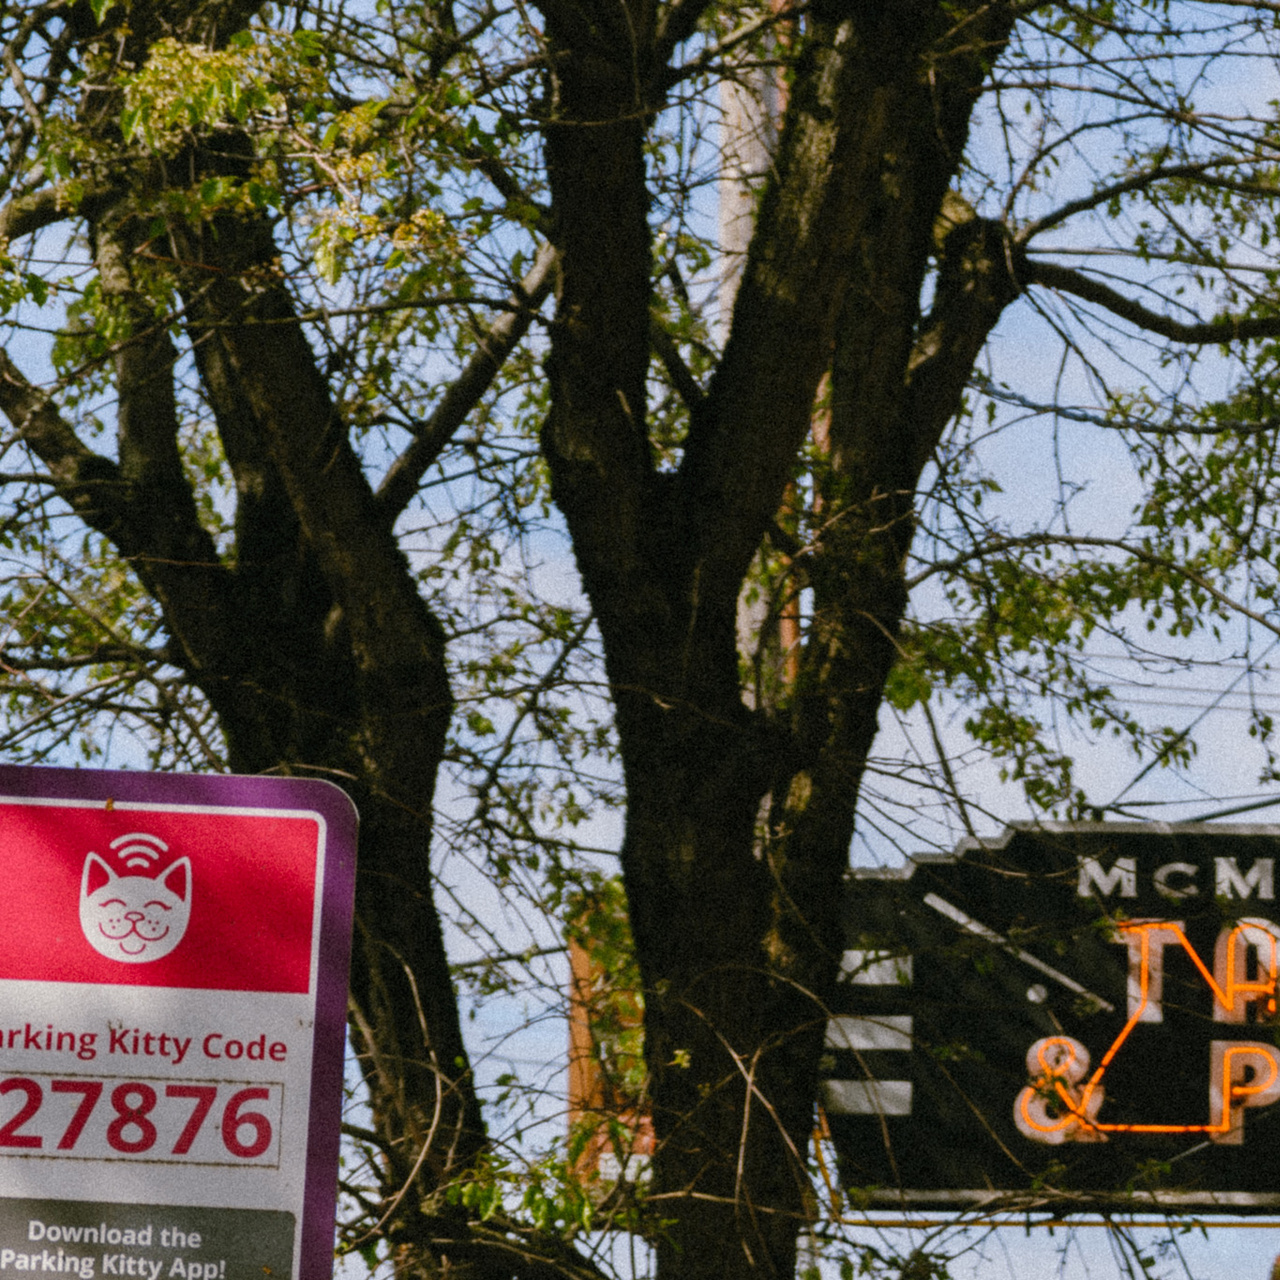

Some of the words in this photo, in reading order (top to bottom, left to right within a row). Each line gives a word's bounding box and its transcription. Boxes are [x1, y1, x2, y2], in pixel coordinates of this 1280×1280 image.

[108, 1028, 192, 1065] Kitty
[202, 1032, 288, 1062] Code
[1013, 1035, 1109, 1145] &
[0, 1077, 273, 1158] 27876
[28, 1220, 153, 1246] Download
[160, 1226, 202, 1248] the
[0, 1248, 95, 1279] Parking
[102, 1253, 163, 1280] Kitty
